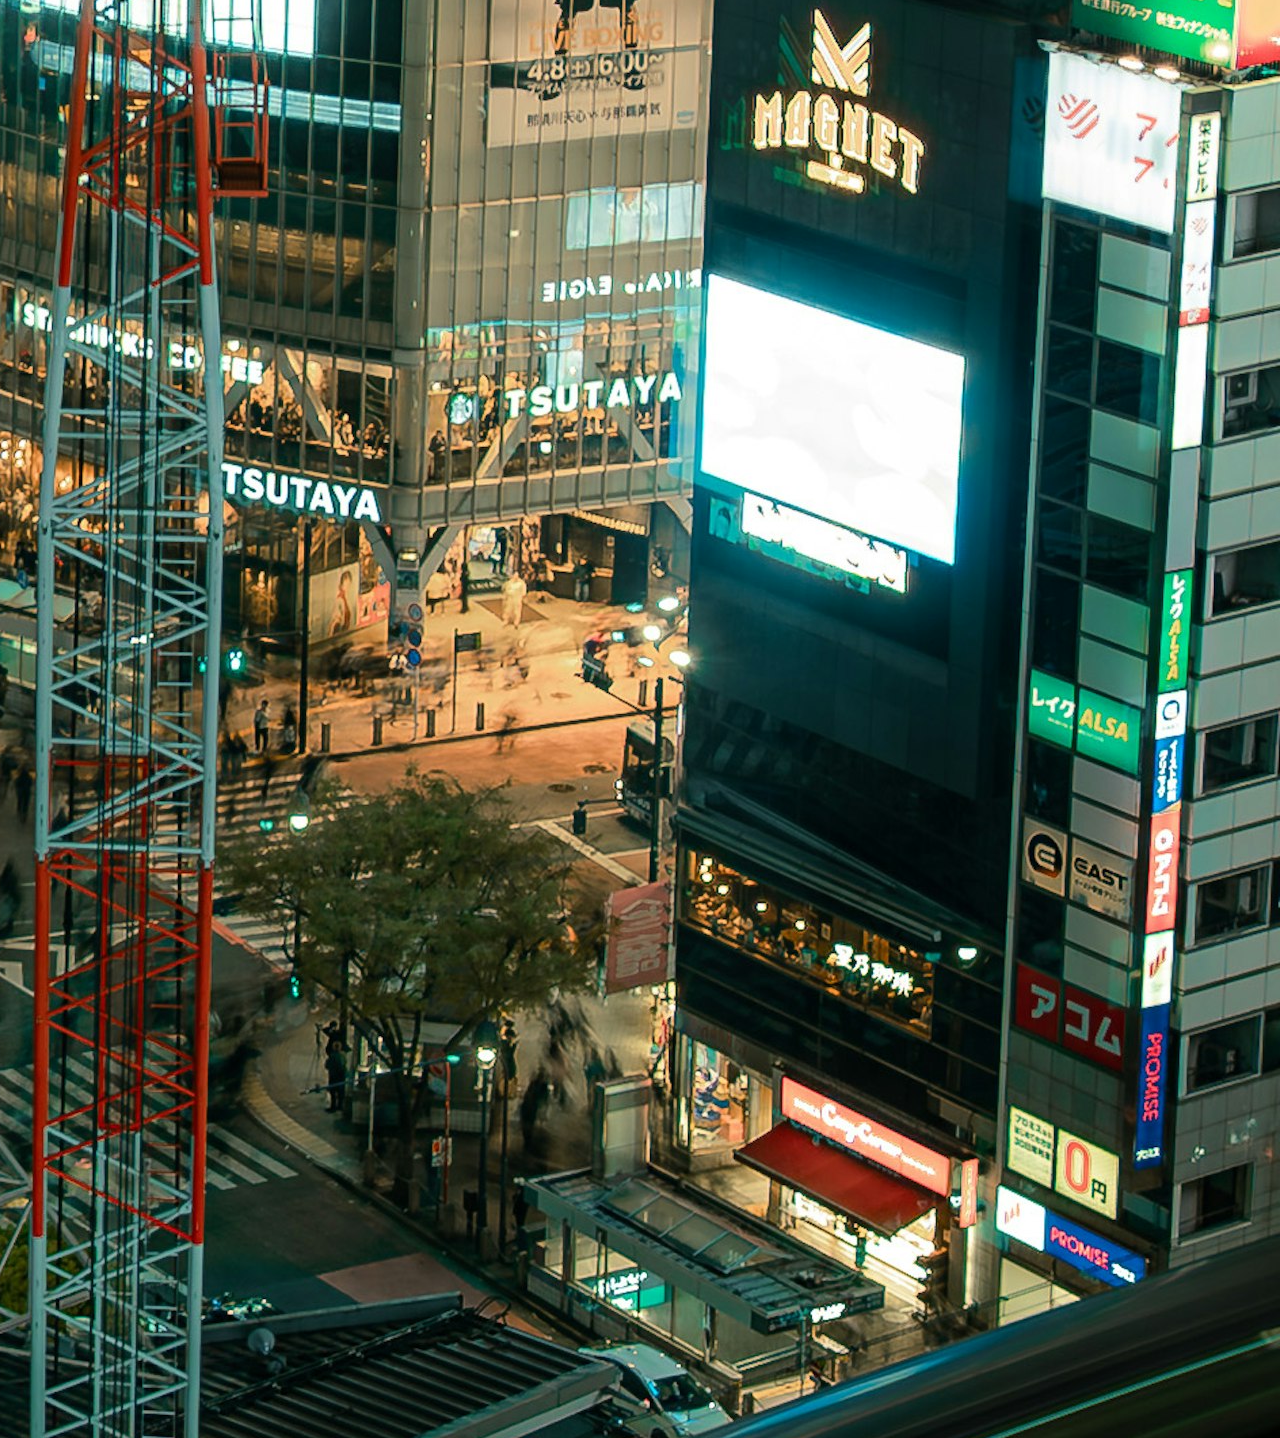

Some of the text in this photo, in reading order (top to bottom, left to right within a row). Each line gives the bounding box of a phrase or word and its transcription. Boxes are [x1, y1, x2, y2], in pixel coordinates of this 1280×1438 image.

[753, 89, 926, 195] MAGNET
[504, 372, 682, 419] TSUTAYA
[223, 461, 383, 524] TSUTAYA
[1166, 617, 1183, 681] ALSA
[1031, 687, 1075, 719] レイク
[1078, 708, 1129, 743] ALSA
[1074, 856, 1128, 892] EAST
[1030, 985, 1127, 1062] アコム
[1142, 1031, 1164, 1122] PROMISE
[1050, 1225, 1110, 1269] PROMISE
